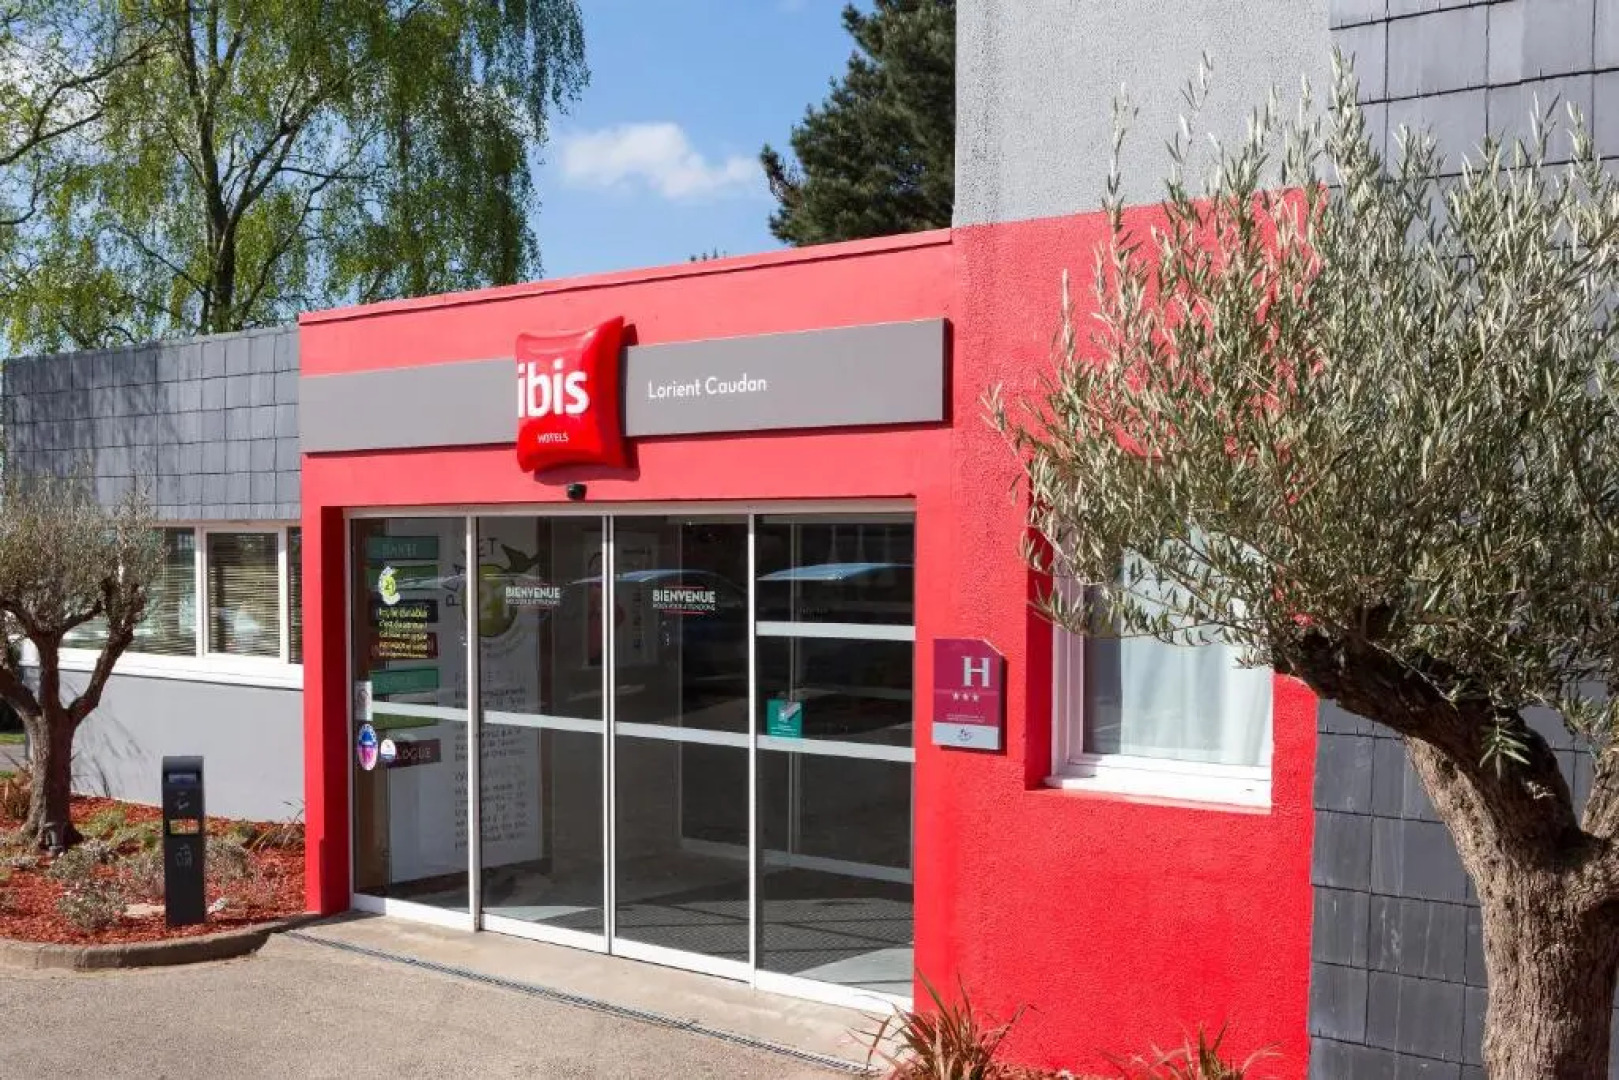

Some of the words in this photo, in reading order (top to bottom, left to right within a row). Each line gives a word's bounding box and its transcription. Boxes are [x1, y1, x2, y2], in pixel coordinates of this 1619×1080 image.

[517, 358, 590, 418] ibis
[647, 379, 701, 399] Lorient
[704, 372, 768, 395] Caudan
[537, 432, 569, 443] HOTELS
[505, 586, 561, 599] BIENVENUE
[652, 589, 716, 603] BIENVENUE
[961, 656, 991, 687] H
